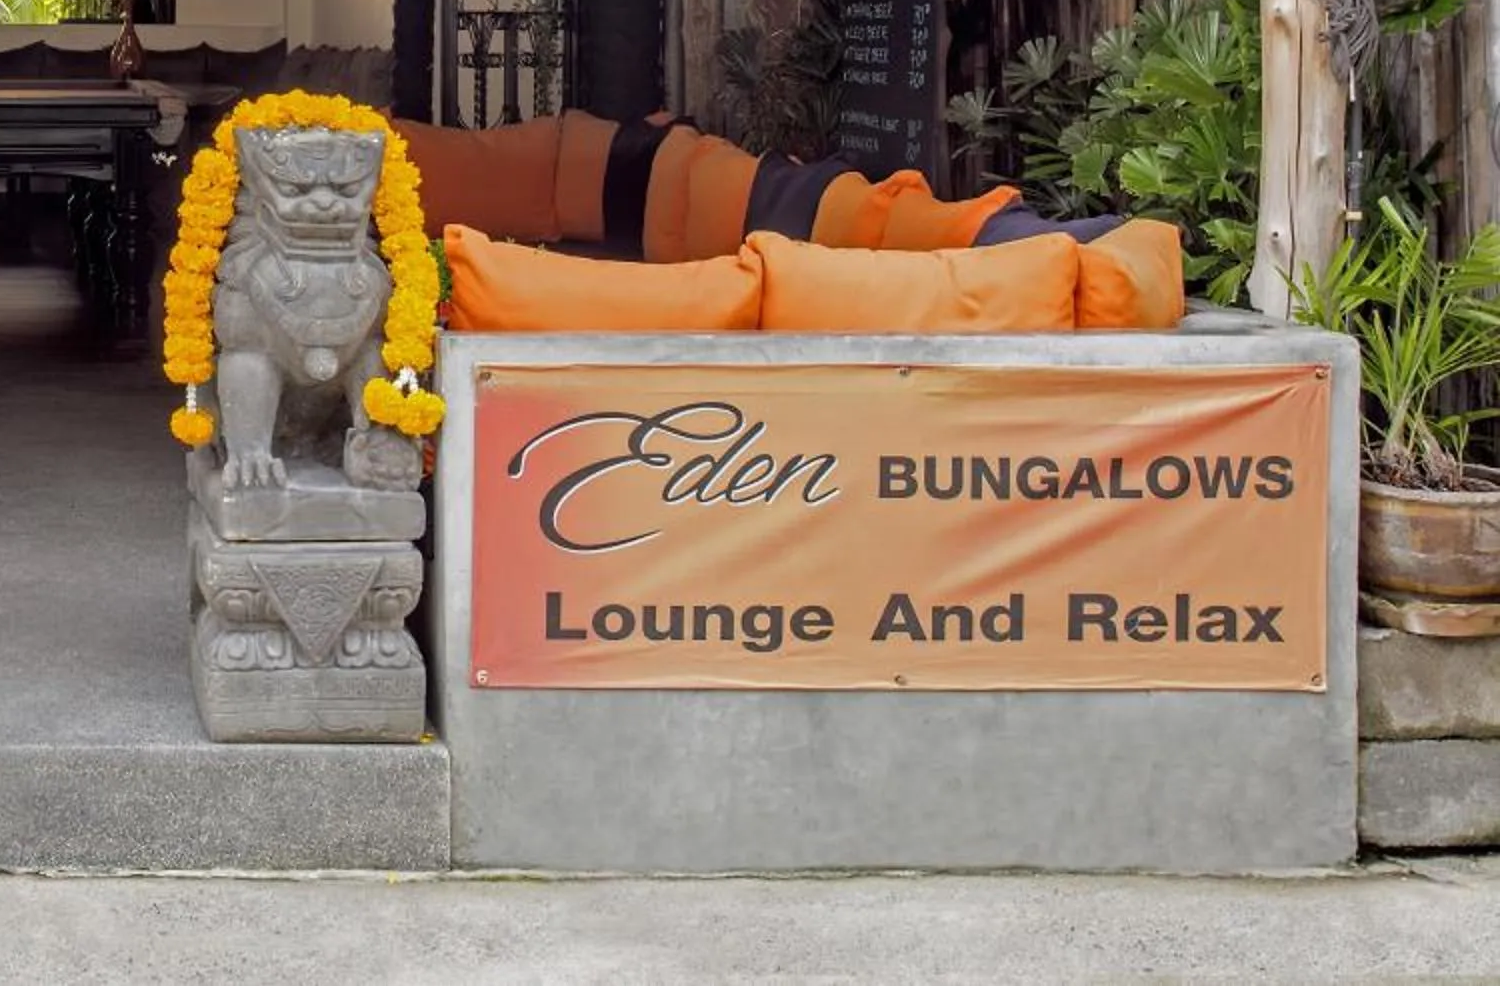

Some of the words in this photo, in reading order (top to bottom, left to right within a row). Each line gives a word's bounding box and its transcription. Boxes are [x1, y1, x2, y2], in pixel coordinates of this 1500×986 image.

[508, 402, 843, 554] Eden
[878, 455, 1294, 500] BUNGALOWS
[545, 592, 835, 653] Lounge
[871, 593, 1025, 642] And
[1067, 593, 1285, 642] Relax
